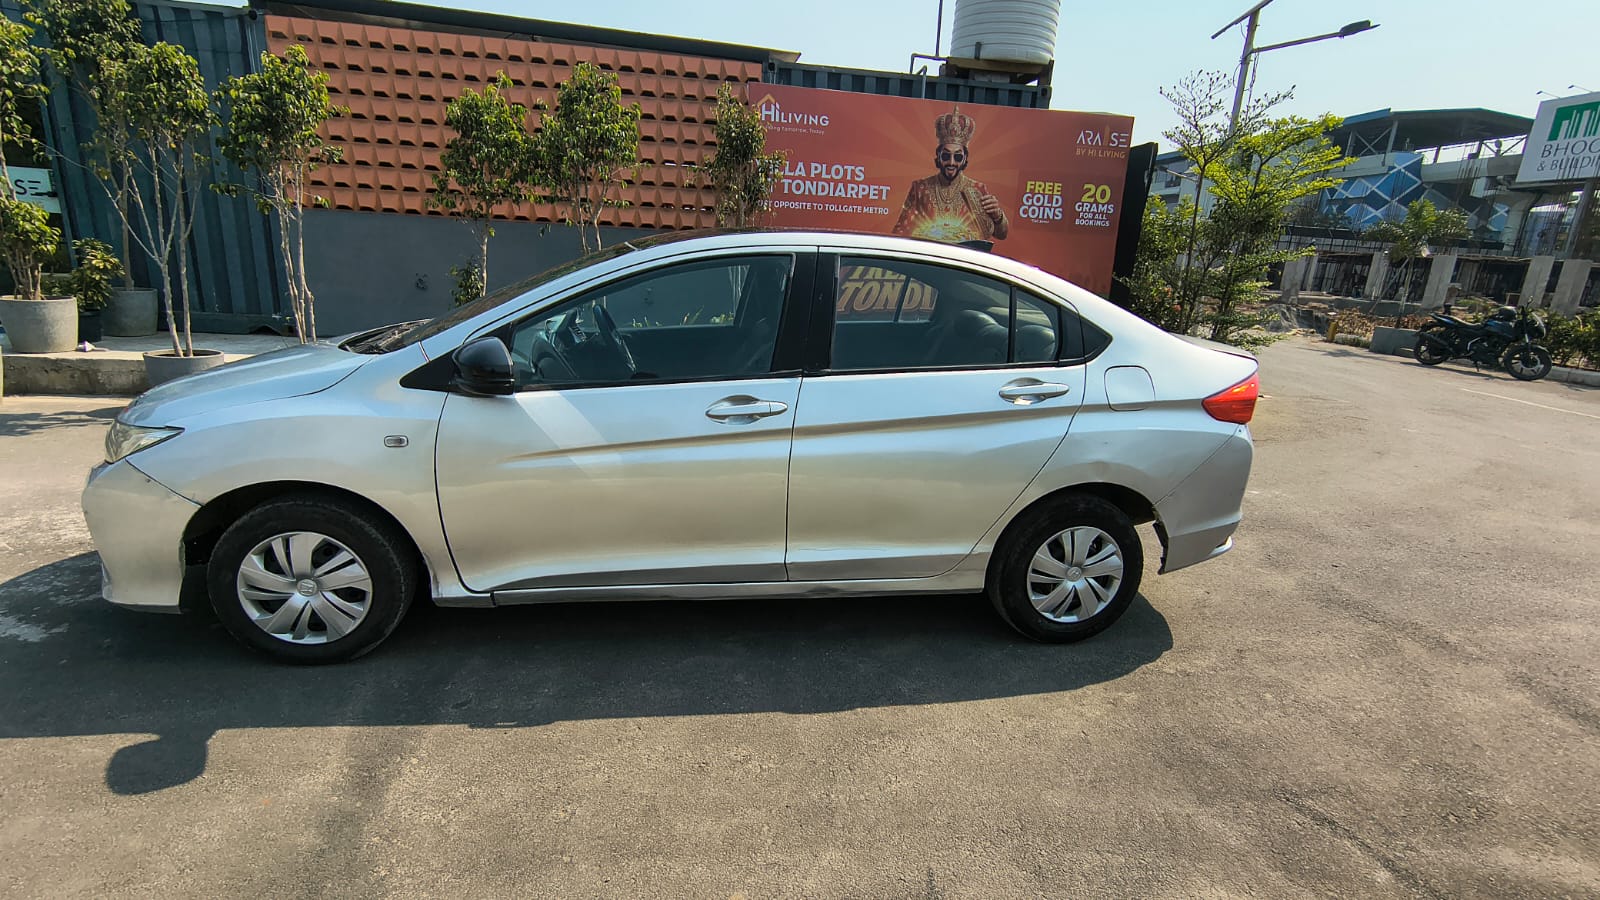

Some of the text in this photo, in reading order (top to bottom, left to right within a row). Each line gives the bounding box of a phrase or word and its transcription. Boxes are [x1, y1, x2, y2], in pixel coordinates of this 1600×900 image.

[1098, 150, 1126, 159] LIVING
[810, 162, 865, 181] PLOTS
[1537, 161, 1546, 171] &
[782, 178, 890, 201] TONDIARPET
[1026, 181, 1062, 195] FREE
[1081, 183, 1111, 204] 20
[1022, 193, 1062, 207] GOLD
[773, 200, 812, 210] OPPOSITE
[813, 203, 823, 211] TO
[824, 204, 862, 213] TOLLGATE
[863, 206, 889, 215] METRO
[1019, 205, 1063, 220] COINS
[1075, 202, 1114, 214] GRAMS
[1075, 219, 1110, 227] BOOKINGS
